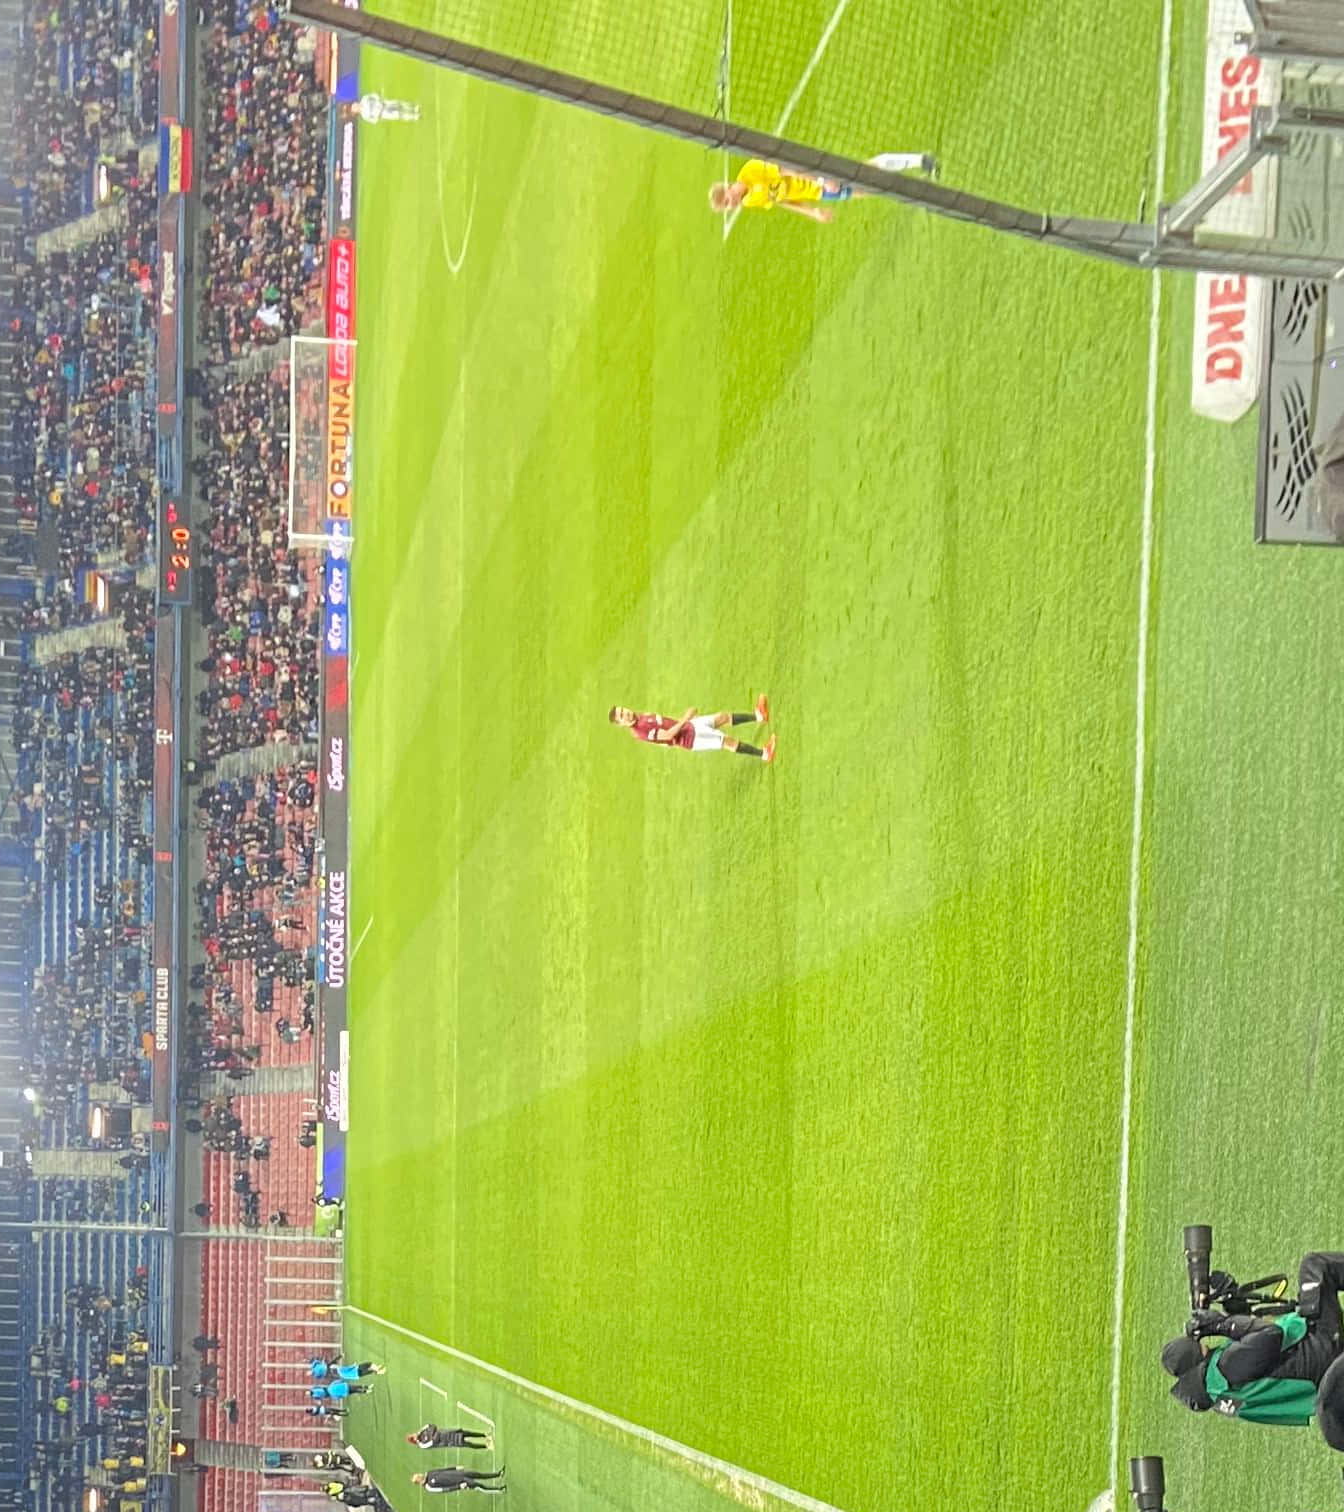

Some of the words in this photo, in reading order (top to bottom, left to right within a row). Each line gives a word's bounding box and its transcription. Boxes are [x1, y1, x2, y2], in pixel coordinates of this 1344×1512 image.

[1216, 56, 1261, 196] NES
[1205, 275, 1248, 385] DNE
[330, 382, 350, 518] FORTUNA
[169, 527, 190, 569] 2:0
[326, 735, 344, 792] iSport.cz
[329, 871, 345, 917] AKCE
[325, 919, 345, 988] ÚTOČNÉ
[156, 967, 169, 1000] CLUB
[156, 1002, 168, 1051] SPARTA
